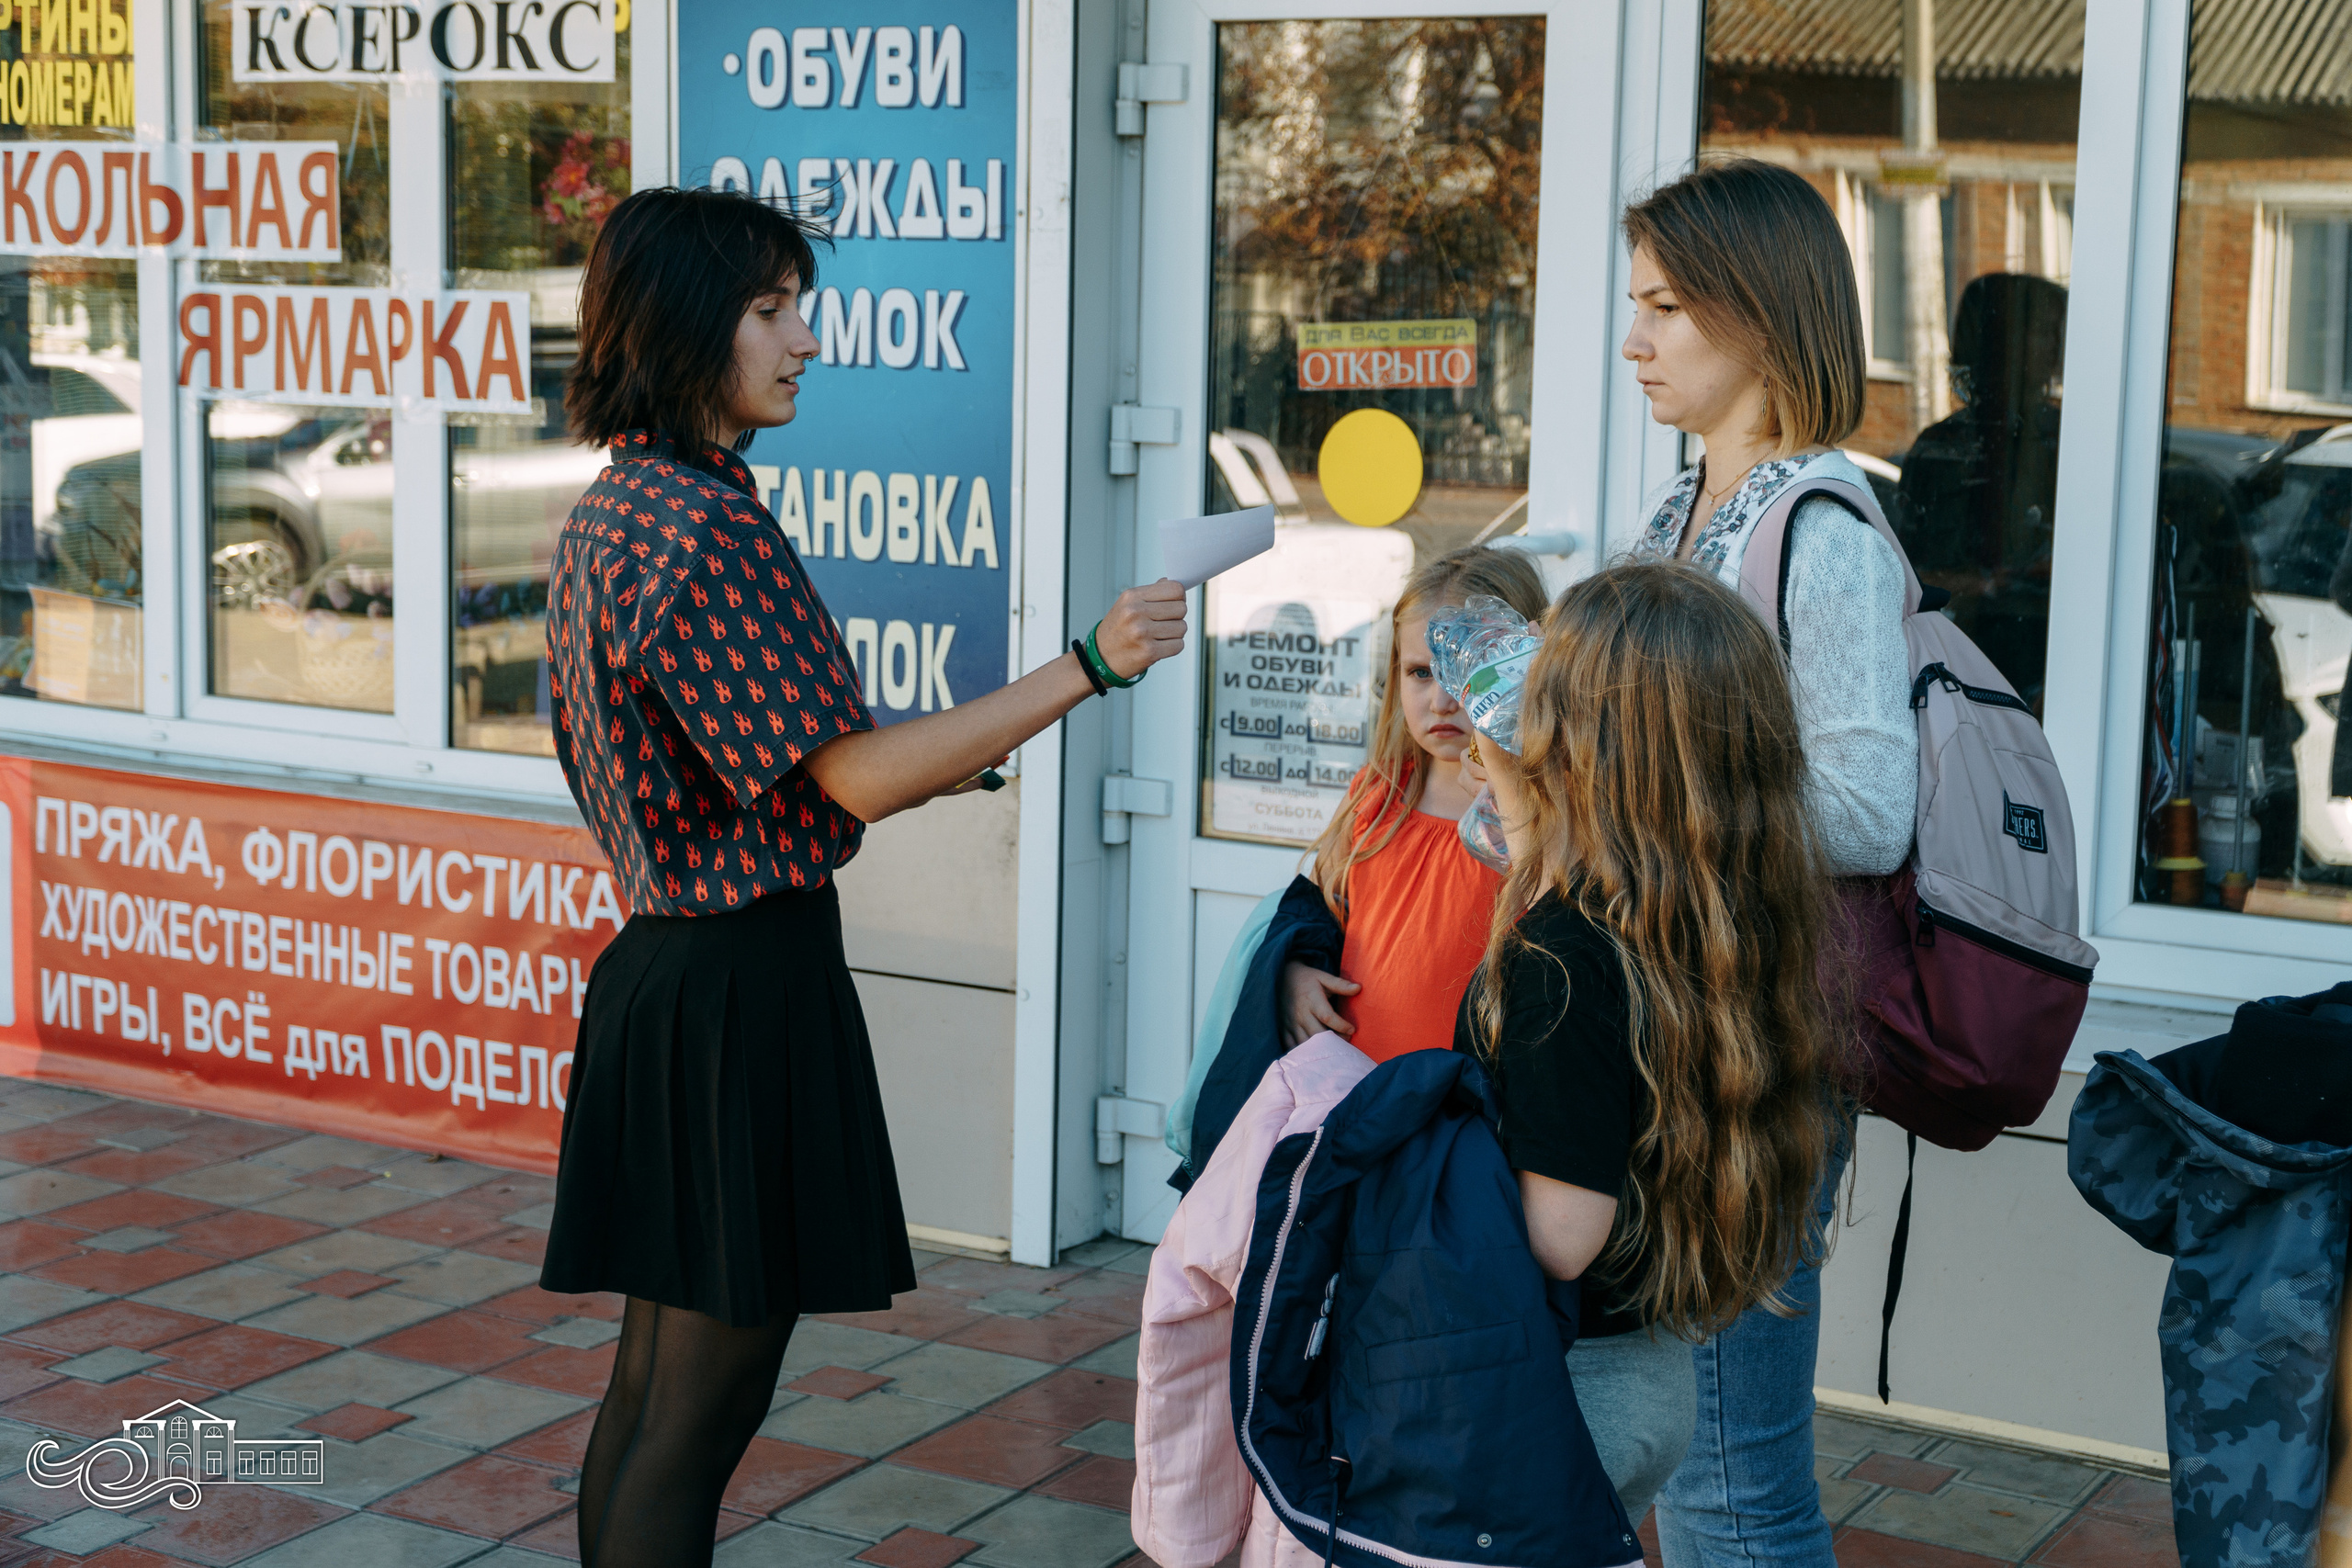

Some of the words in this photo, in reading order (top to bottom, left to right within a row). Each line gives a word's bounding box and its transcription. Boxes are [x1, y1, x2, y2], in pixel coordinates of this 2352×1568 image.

[247, 0, 602, 73] КСЕРОКС
[746, 24, 964, 109] ОБУВИ
[3, 150, 337, 249] КОЛЬНАЯ
[179, 292, 526, 402] ЯРМАРКА
[1303, 348, 1472, 387] ОТКРЫТО
[831, 615, 956, 712] ПОК
[1224, 672, 1240, 688] И
[1247, 674, 1362, 699] ОДЕЖДЫ
[1251, 655, 1334, 676] ОБУВИ
[1238, 716, 1276, 733] 9.00
[1316, 724, 1360, 741] 18.00
[1263, 740, 1317, 757] ПЕРЕРЫВ
[1233, 760, 1277, 777] 12.00
[1255, 802, 1324, 819] СУББОТА
[36, 795, 226, 891] ПРЯЖА,
[241, 826, 635, 933] ФЛОРИСТИКА
[40, 880, 414, 997] ХУДОЖЕСТВЕННЫЕ
[40, 966, 172, 1057] ИГРЫ,
[184, 990, 273, 1066] ВСЁ
[284, 1025, 370, 1081] для
